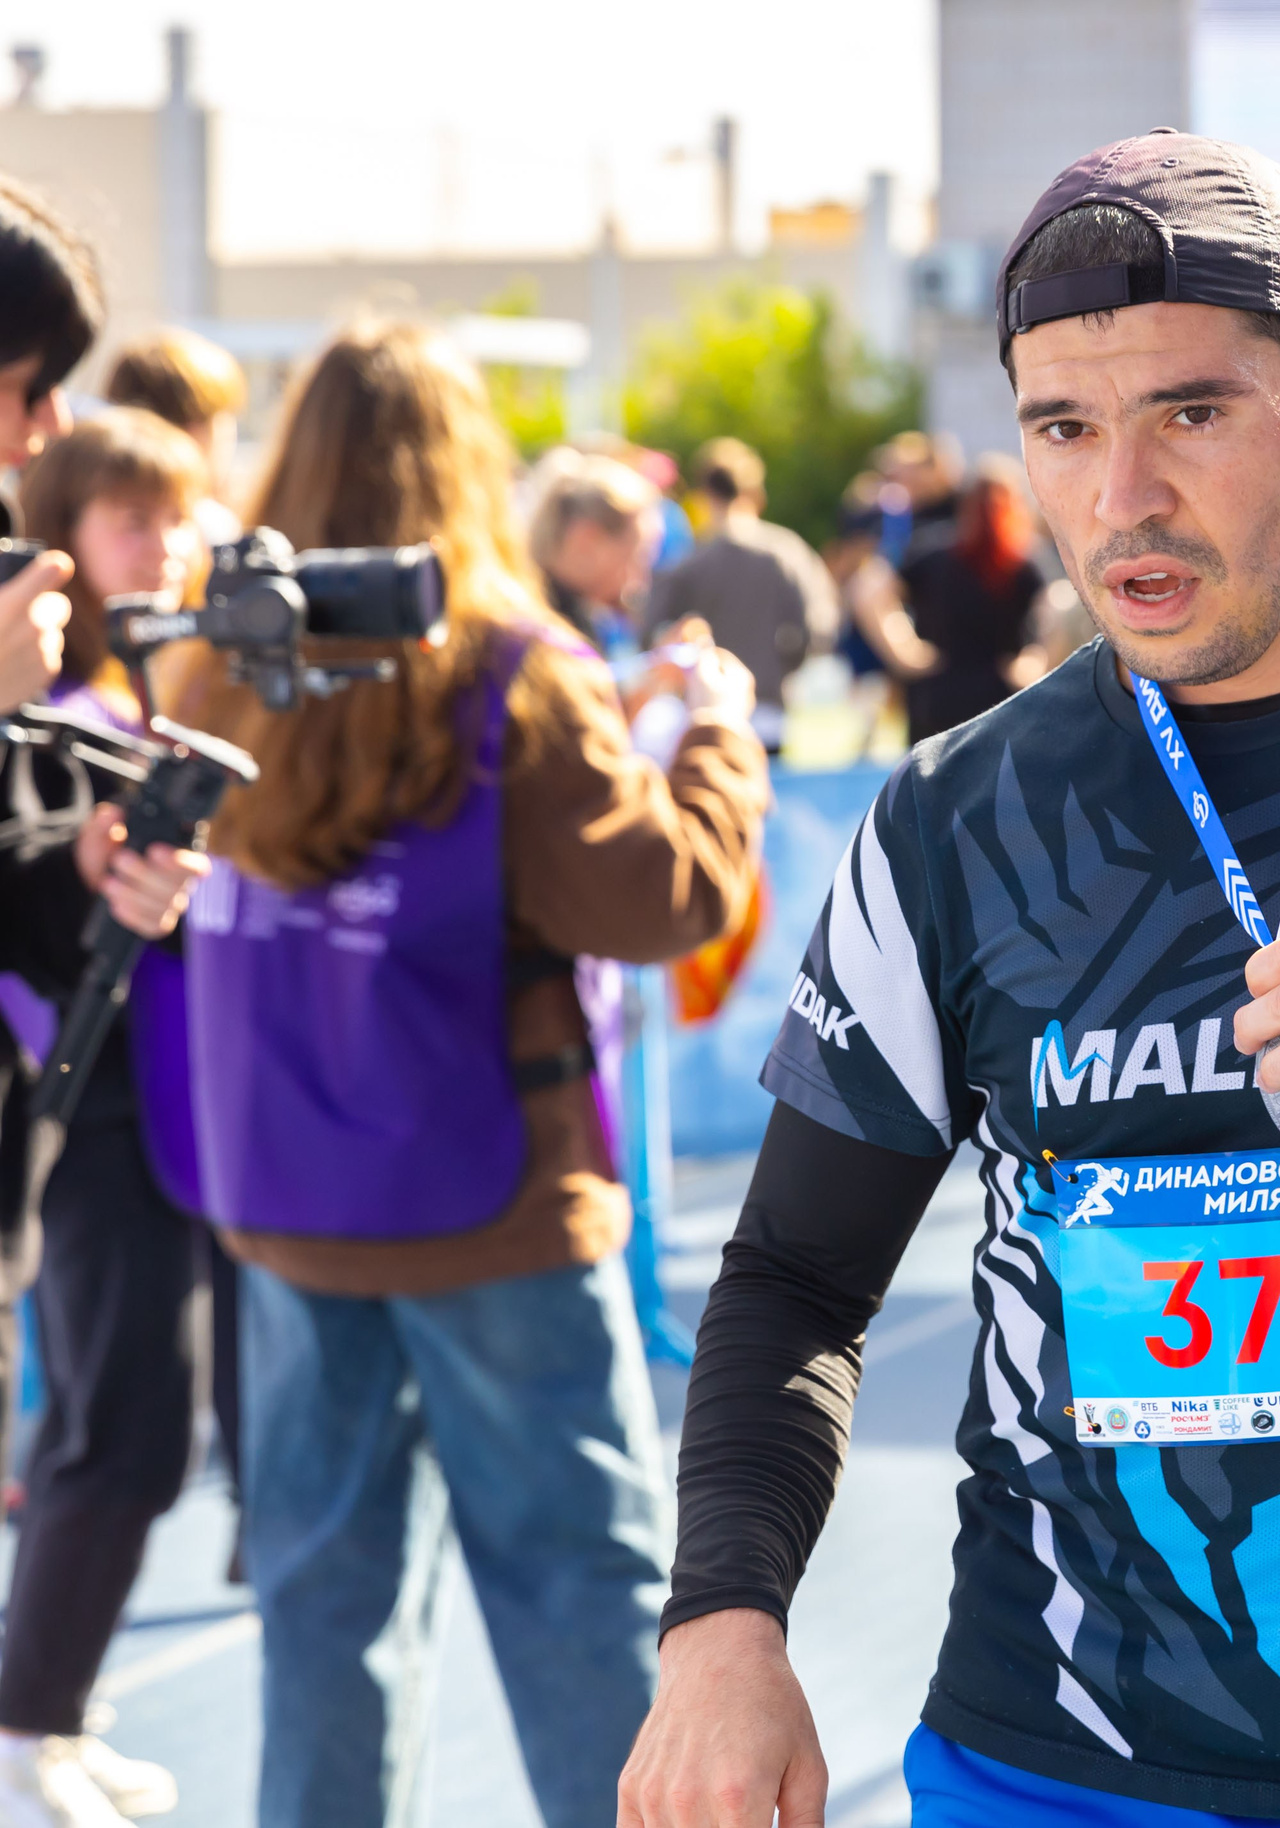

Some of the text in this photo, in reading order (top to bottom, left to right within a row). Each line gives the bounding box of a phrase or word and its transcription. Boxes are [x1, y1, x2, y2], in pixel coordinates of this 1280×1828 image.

[1139, 677, 1167, 726] ДИ
[1030, 1018, 1258, 1109] MAL
[1140, 1402, 1158, 1411] ВТБ
[1171, 1400, 1208, 1412] Nika
